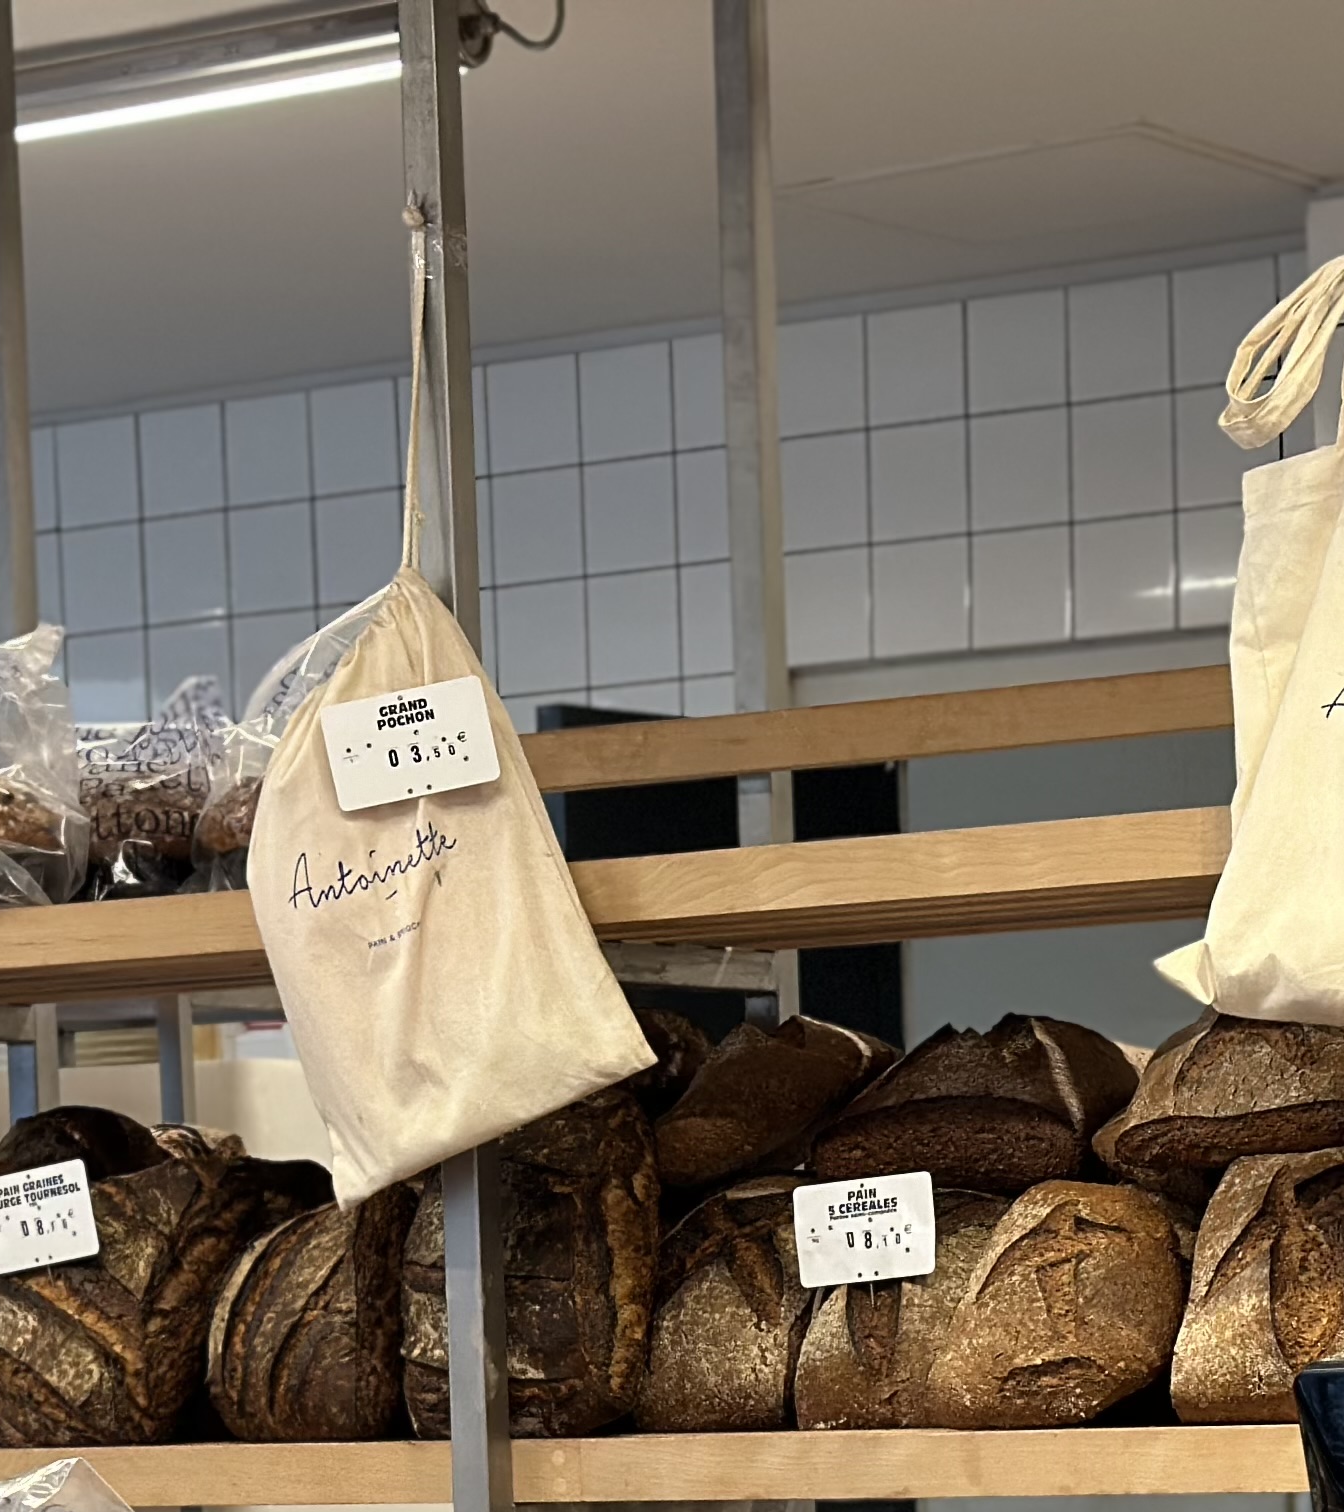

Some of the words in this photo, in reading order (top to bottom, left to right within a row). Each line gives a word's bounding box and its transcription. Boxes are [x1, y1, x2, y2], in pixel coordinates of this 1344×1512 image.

[379, 698, 428, 718] GRAND
[376, 708, 435, 731] POCHON
[288, 821, 457, 909] Antoinette
[23, 1174, 64, 1192] GRAINES
[24, 1182, 80, 1203] TOURNESOL
[847, 1188, 877, 1201] PAIN
[828, 1205, 835, 1216] 5
[839, 1197, 897, 1215] CEREALES
